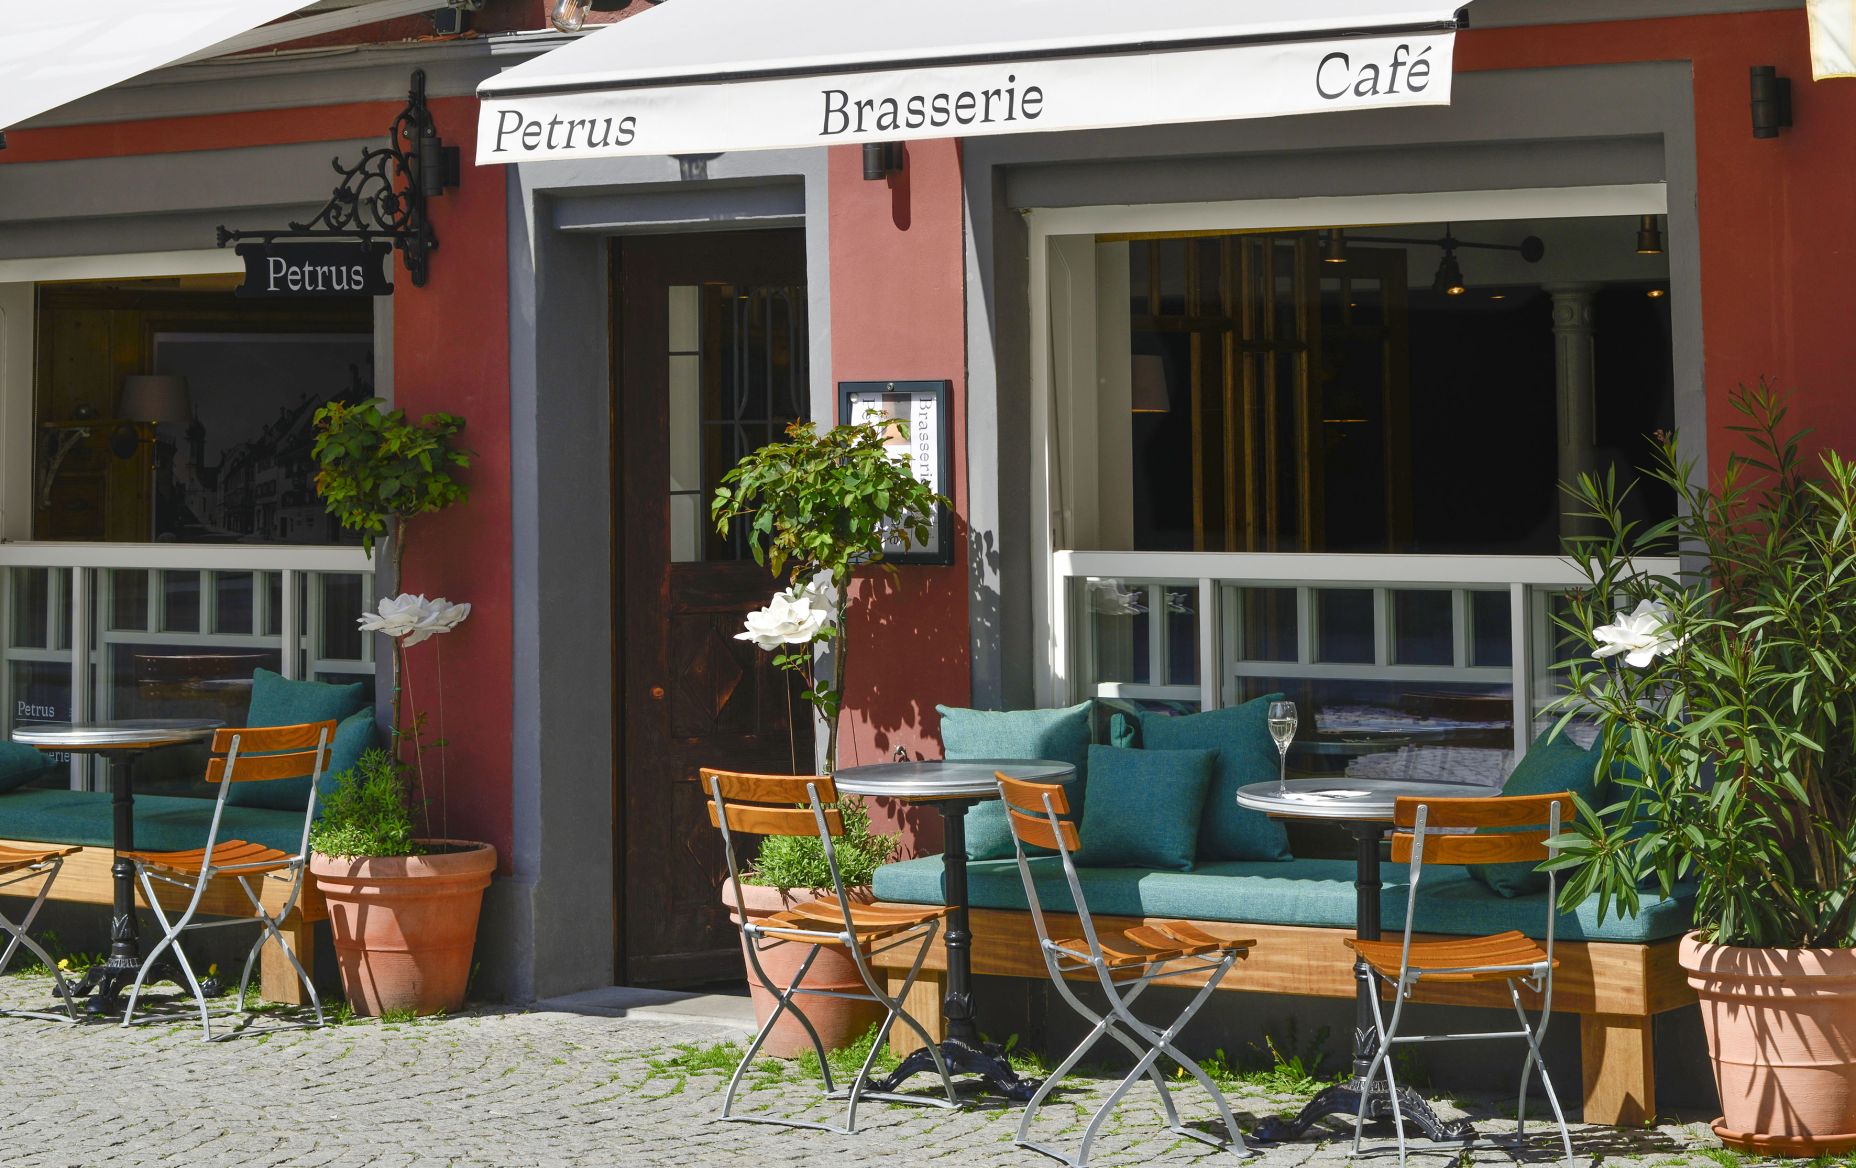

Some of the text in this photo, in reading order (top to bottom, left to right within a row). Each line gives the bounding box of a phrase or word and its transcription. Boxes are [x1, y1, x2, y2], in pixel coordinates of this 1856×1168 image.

[492, 44, 1431, 153] Petrus Brasserie Café
[267, 257, 363, 290] Petrus
[17, 701, 54, 717] Petrus
